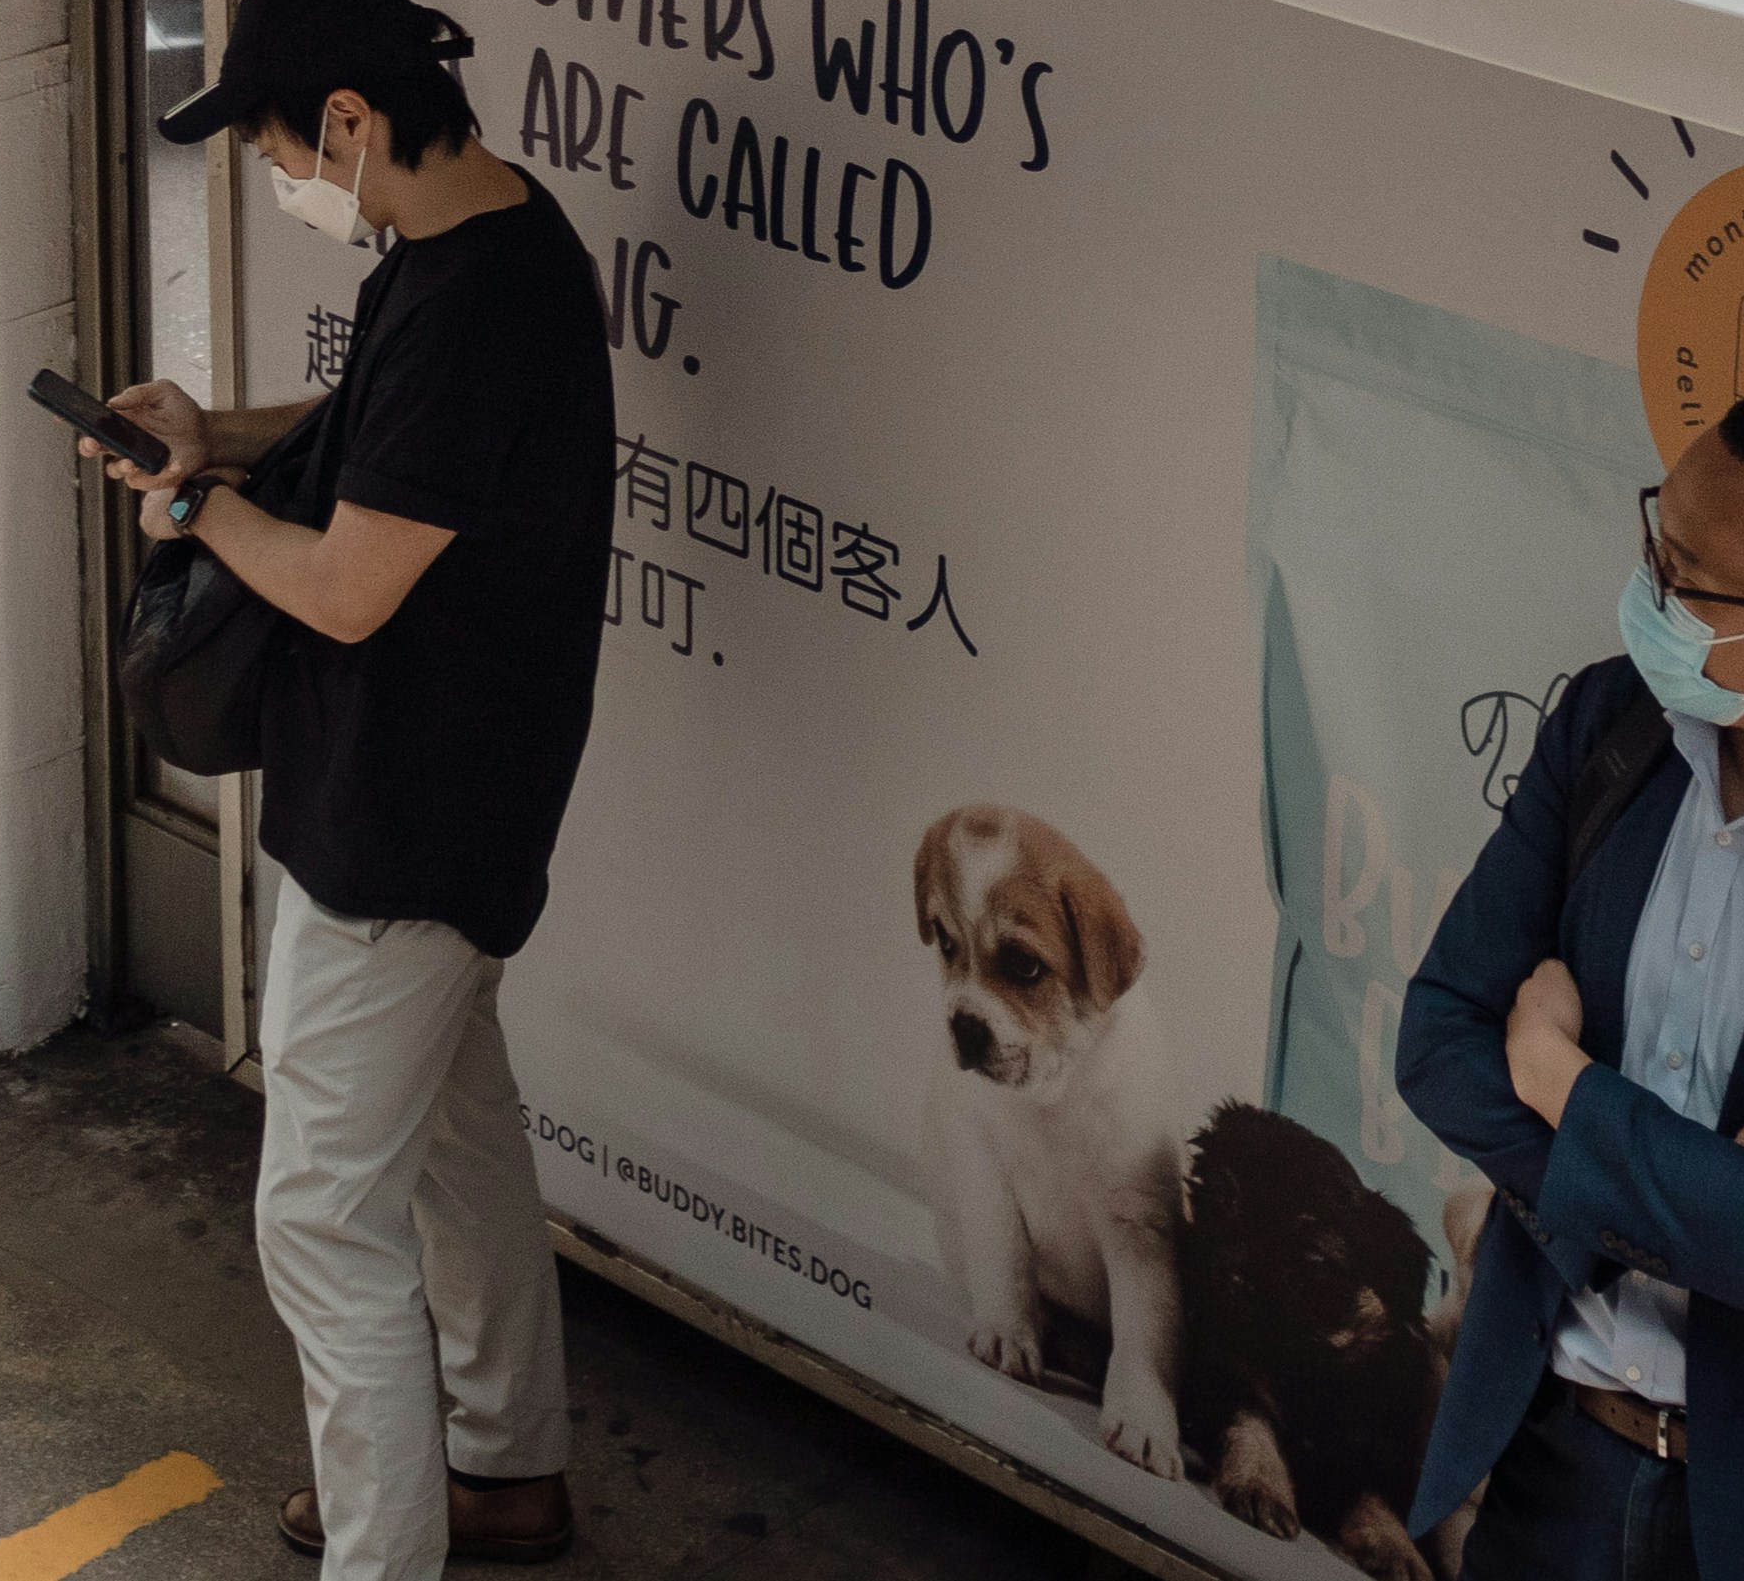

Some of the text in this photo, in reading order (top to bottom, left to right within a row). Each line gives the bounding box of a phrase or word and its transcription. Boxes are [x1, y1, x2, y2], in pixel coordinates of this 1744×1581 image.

[520, 47, 932, 290] ARE CALLED
[588, 236, 701, 376] NG.
[1676, 346, 1706, 428] deli
[616, 433, 978, 658] 有四個客人
[518, 1104, 595, 1166] S.DOG
[616, 1155, 872, 1311] @BUDDY.BITES.DOG
